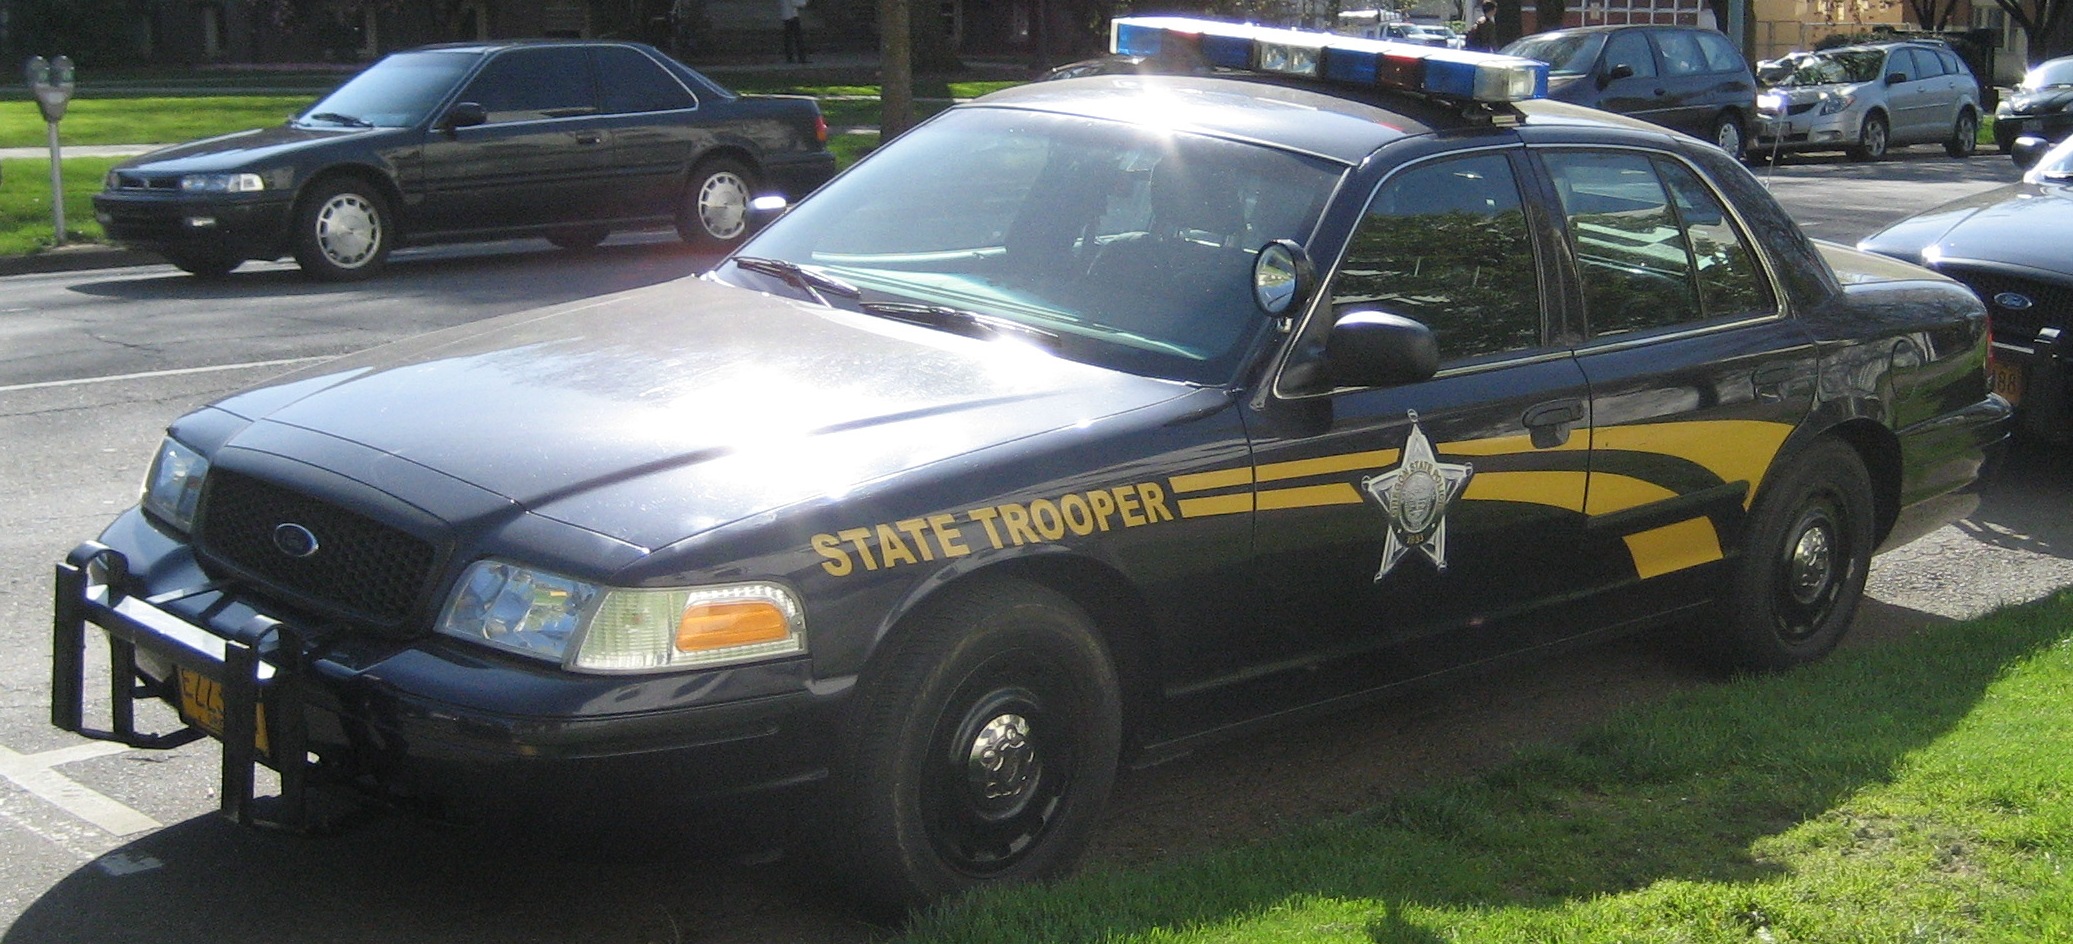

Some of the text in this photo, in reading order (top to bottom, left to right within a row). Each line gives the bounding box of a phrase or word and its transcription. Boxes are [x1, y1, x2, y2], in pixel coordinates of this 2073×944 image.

[1409, 460, 1433, 474] STATE
[810, 481, 1174, 577] STATE TROOPER
